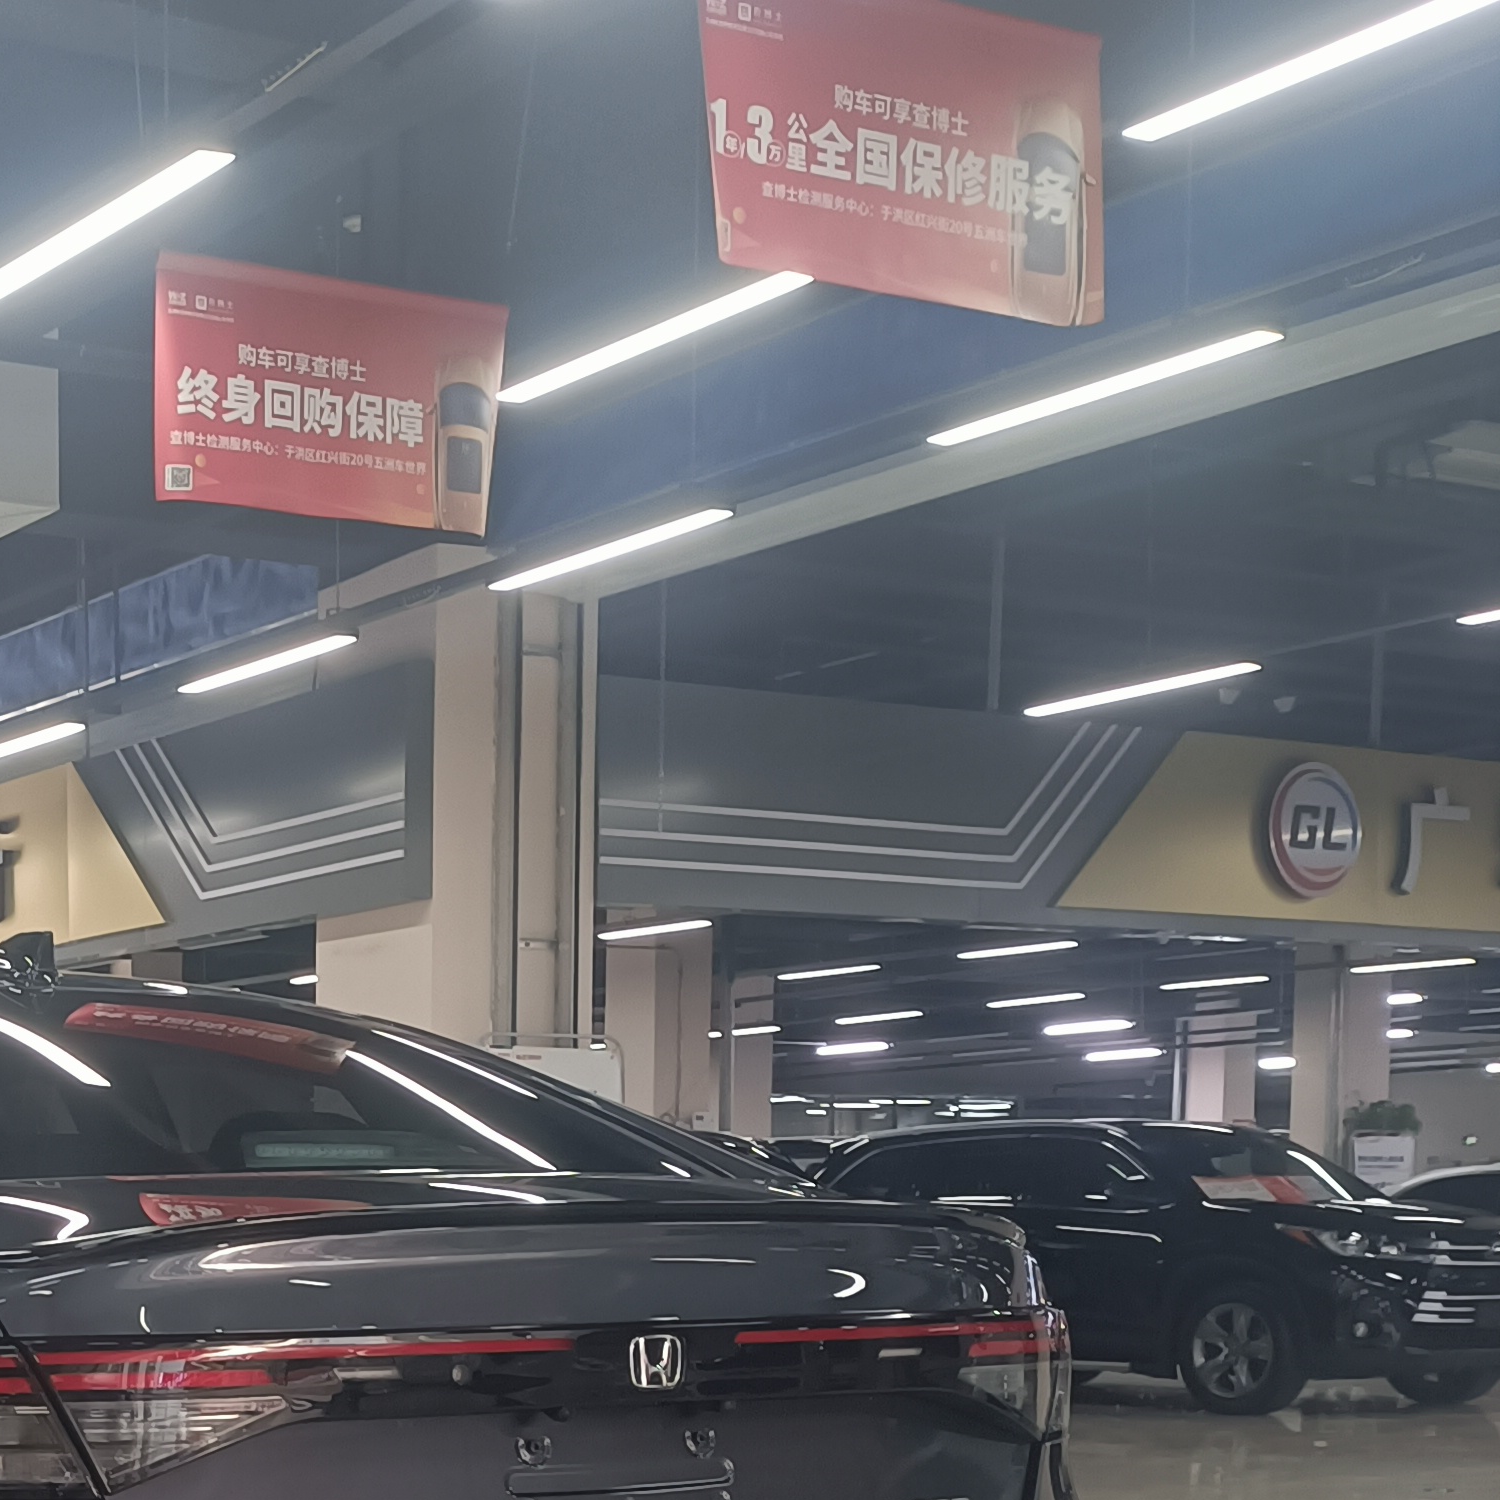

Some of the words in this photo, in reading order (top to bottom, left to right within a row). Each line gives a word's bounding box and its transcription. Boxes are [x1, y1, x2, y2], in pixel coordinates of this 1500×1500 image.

[833, 84, 970, 138] 购车可享查博士
[237, 343, 367, 383] 购车可享查博士
[176, 365, 424, 448] 终身回购保障
[1288, 804, 1349, 851] GL
[1400, 785, 1471, 896] 广
